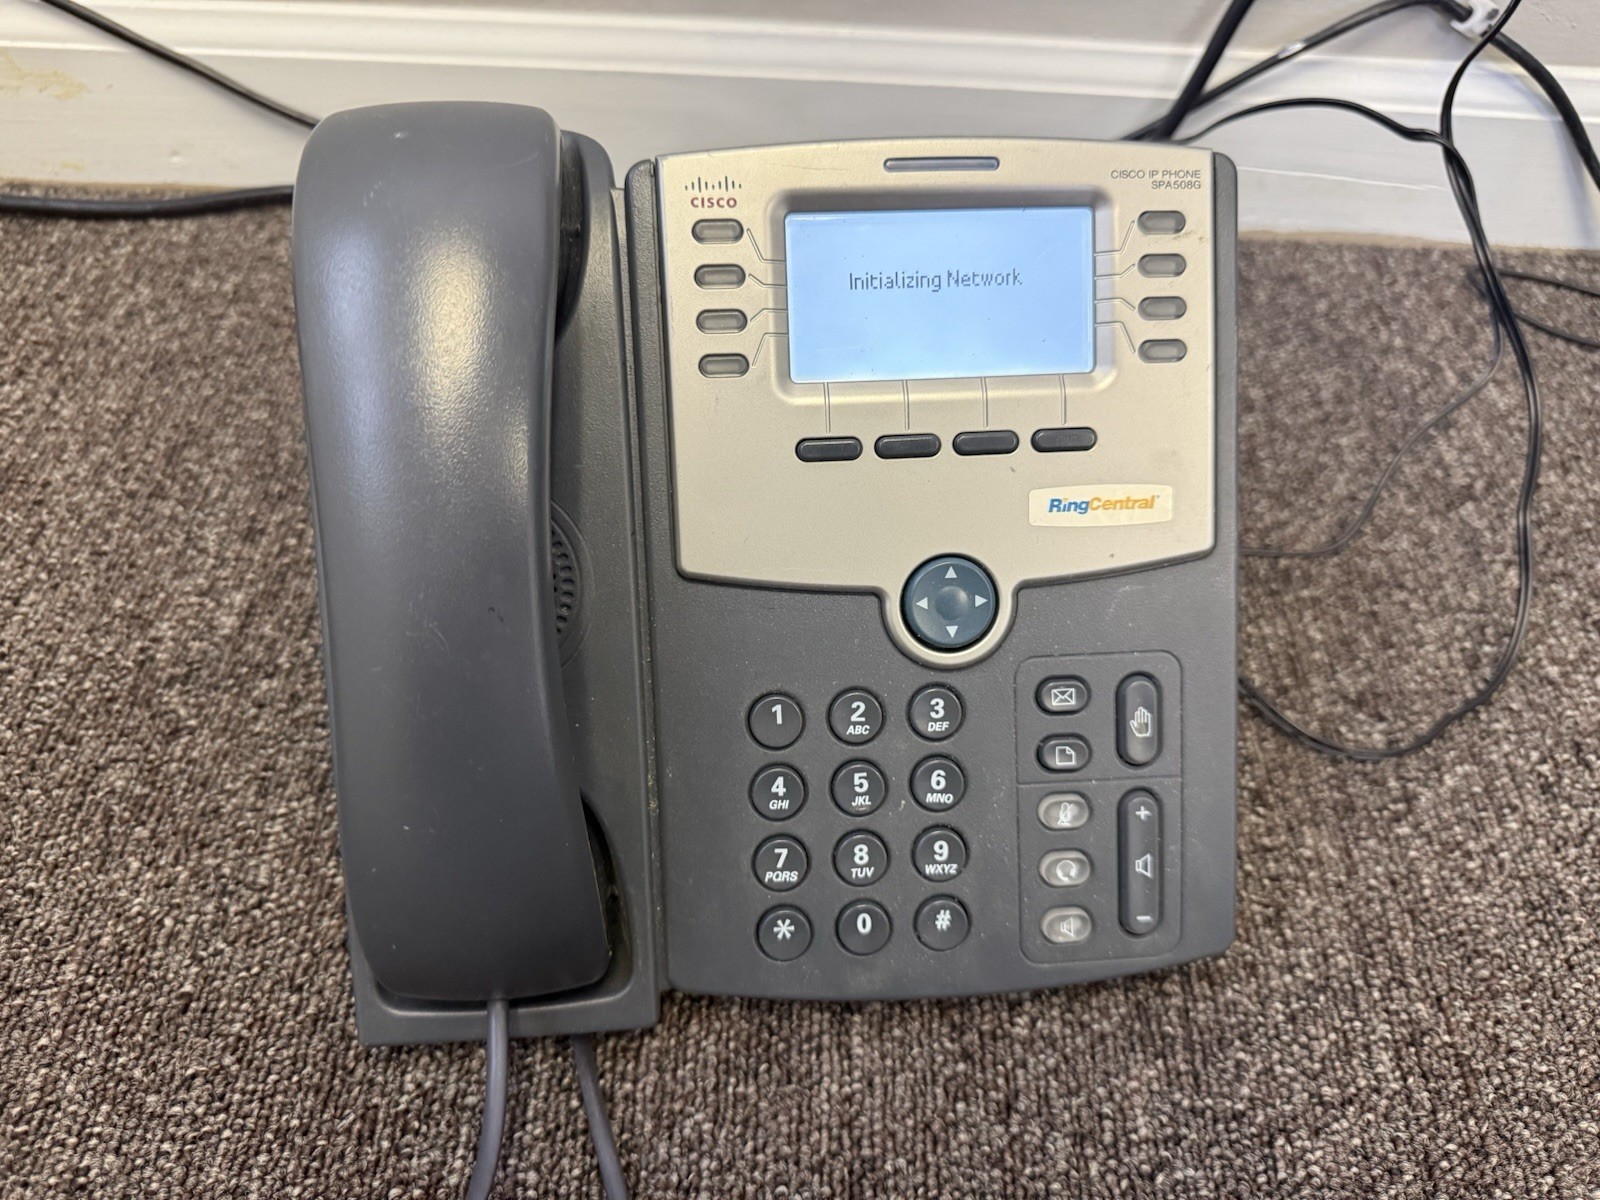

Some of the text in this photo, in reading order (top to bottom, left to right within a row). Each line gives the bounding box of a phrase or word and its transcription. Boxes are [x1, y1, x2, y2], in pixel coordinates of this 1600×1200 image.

[1110, 169, 1202, 180] CISCO IP PHONE
[1151, 180, 1202, 190] SPA508G
[690, 196, 738, 209] CISCO
[849, 268, 1023, 293] Initializing Network
[1048, 494, 1157, 515] RingCentral
[771, 704, 783, 725] 1
[850, 702, 866, 722] 2
[929, 697, 945, 719] 3
[845, 724, 871, 735] ABC
[927, 721, 950, 732] DEF
[770, 776, 787, 797] 4
[853, 772, 869, 793] 5
[930, 769, 946, 791] 6
[768, 799, 790, 810] GHI
[851, 794, 872, 807] JKL
[925, 792, 954, 804] MNO
[774, 847, 789, 869] 7
[853, 844, 869, 865] 8
[933, 840, 949, 862] 9
[764, 870, 799, 883] PQRS
[850, 866, 875, 879] TUV
[925, 863, 958, 875] WXYZ
[856, 912, 872, 934] 0
